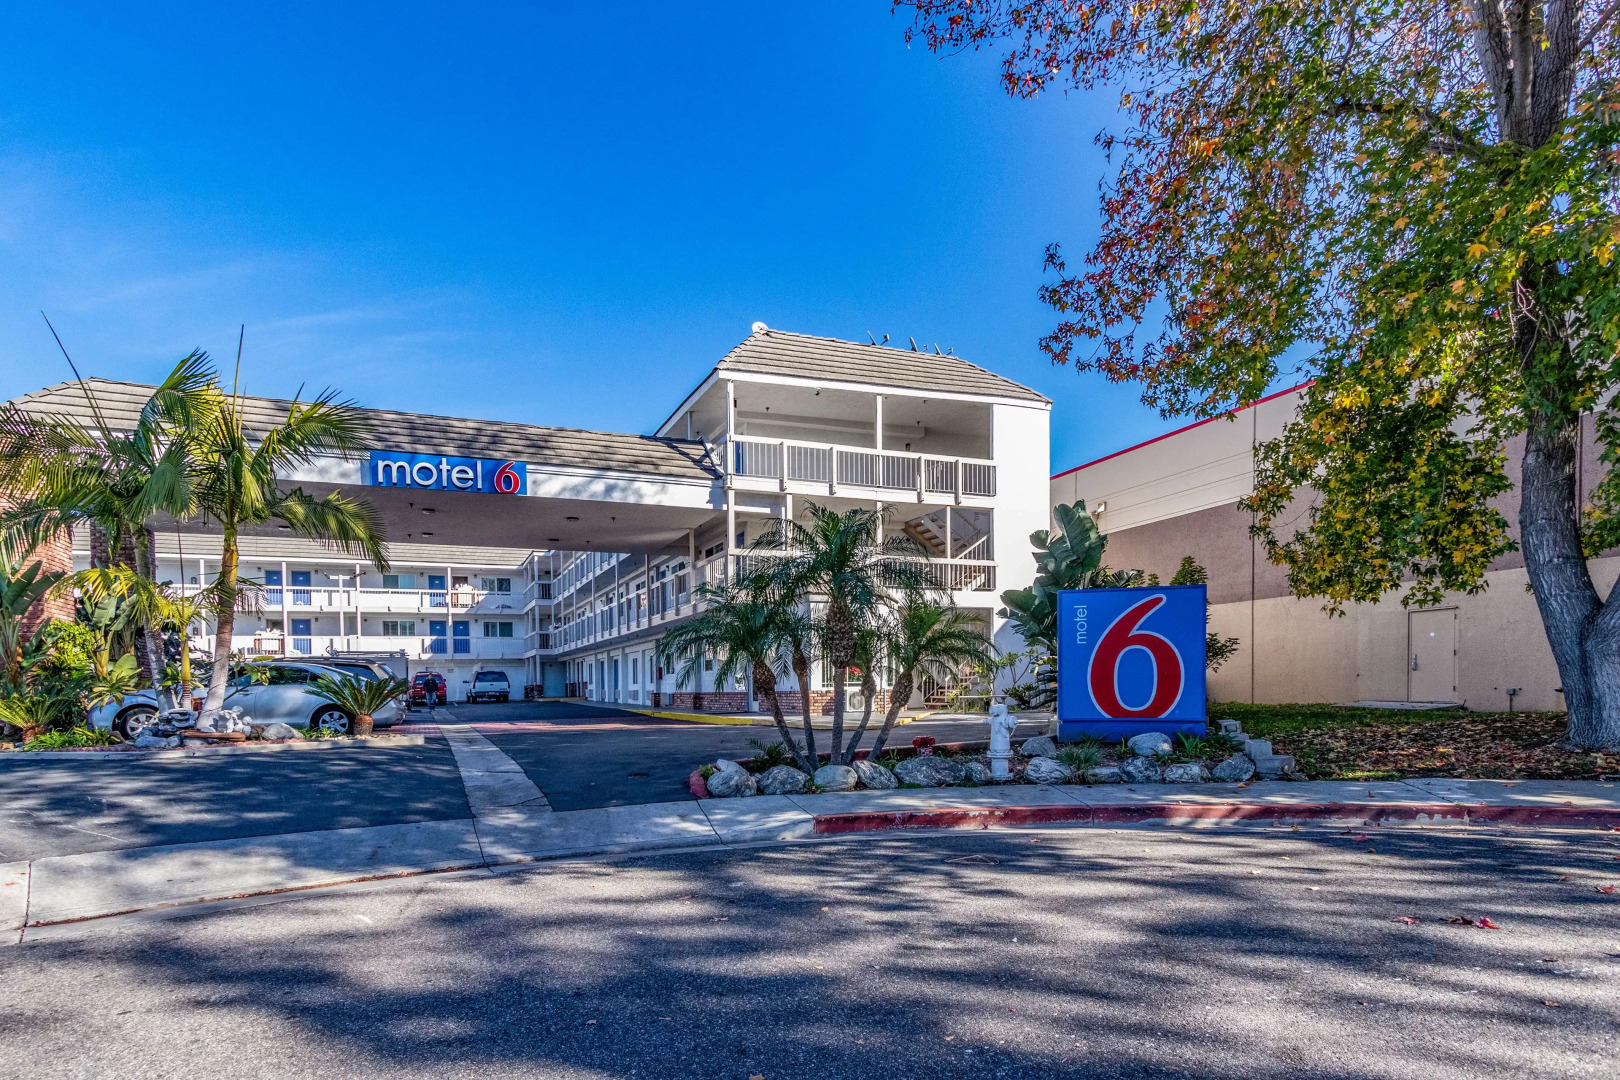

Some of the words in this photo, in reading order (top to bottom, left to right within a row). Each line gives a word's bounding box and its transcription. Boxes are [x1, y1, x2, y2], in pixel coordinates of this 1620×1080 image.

[377, 457, 482, 489] motel
[494, 461, 521, 494] 6
[1074, 605, 1087, 644] motel
[1087, 593, 1185, 718] 6
